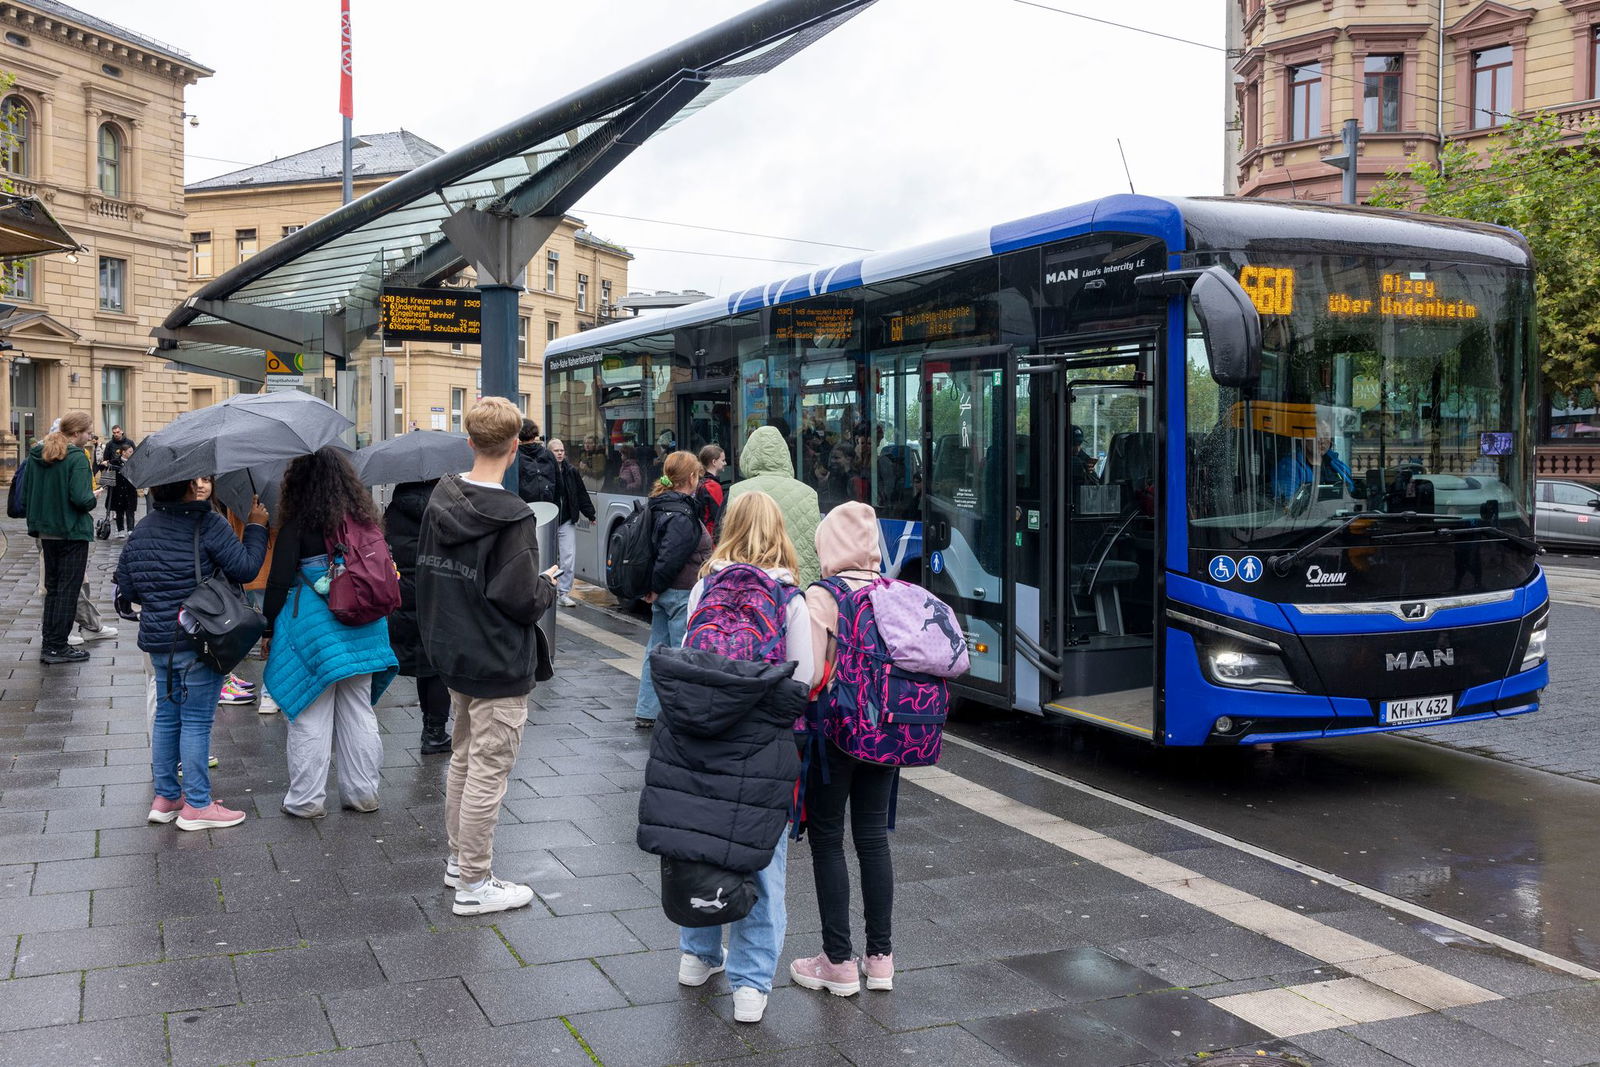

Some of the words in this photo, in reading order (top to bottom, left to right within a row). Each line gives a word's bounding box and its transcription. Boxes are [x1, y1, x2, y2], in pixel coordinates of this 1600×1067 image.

[1045, 268, 1079, 284] MAN
[1082, 267, 1101, 278] Lion's
[1103, 261, 1134, 274] Intercity
[1136, 259, 1145, 268] LE
[1382, 273, 1435, 297] Alzey
[396, 296, 408, 304] Bad
[410, 297, 443, 306] Kreuznach
[445, 299, 457, 307] Bhf
[1329, 294, 1372, 313] über
[1380, 296, 1477, 318] Undenheim
[429, 311, 455, 319] Bahnhof
[416, 554, 478, 581] PEGADOR
[1385, 648, 1454, 671] MAN
[1391, 703, 1408, 720] KH
[1415, 701, 1424, 717] K
[1426, 698, 1448, 715] 432
